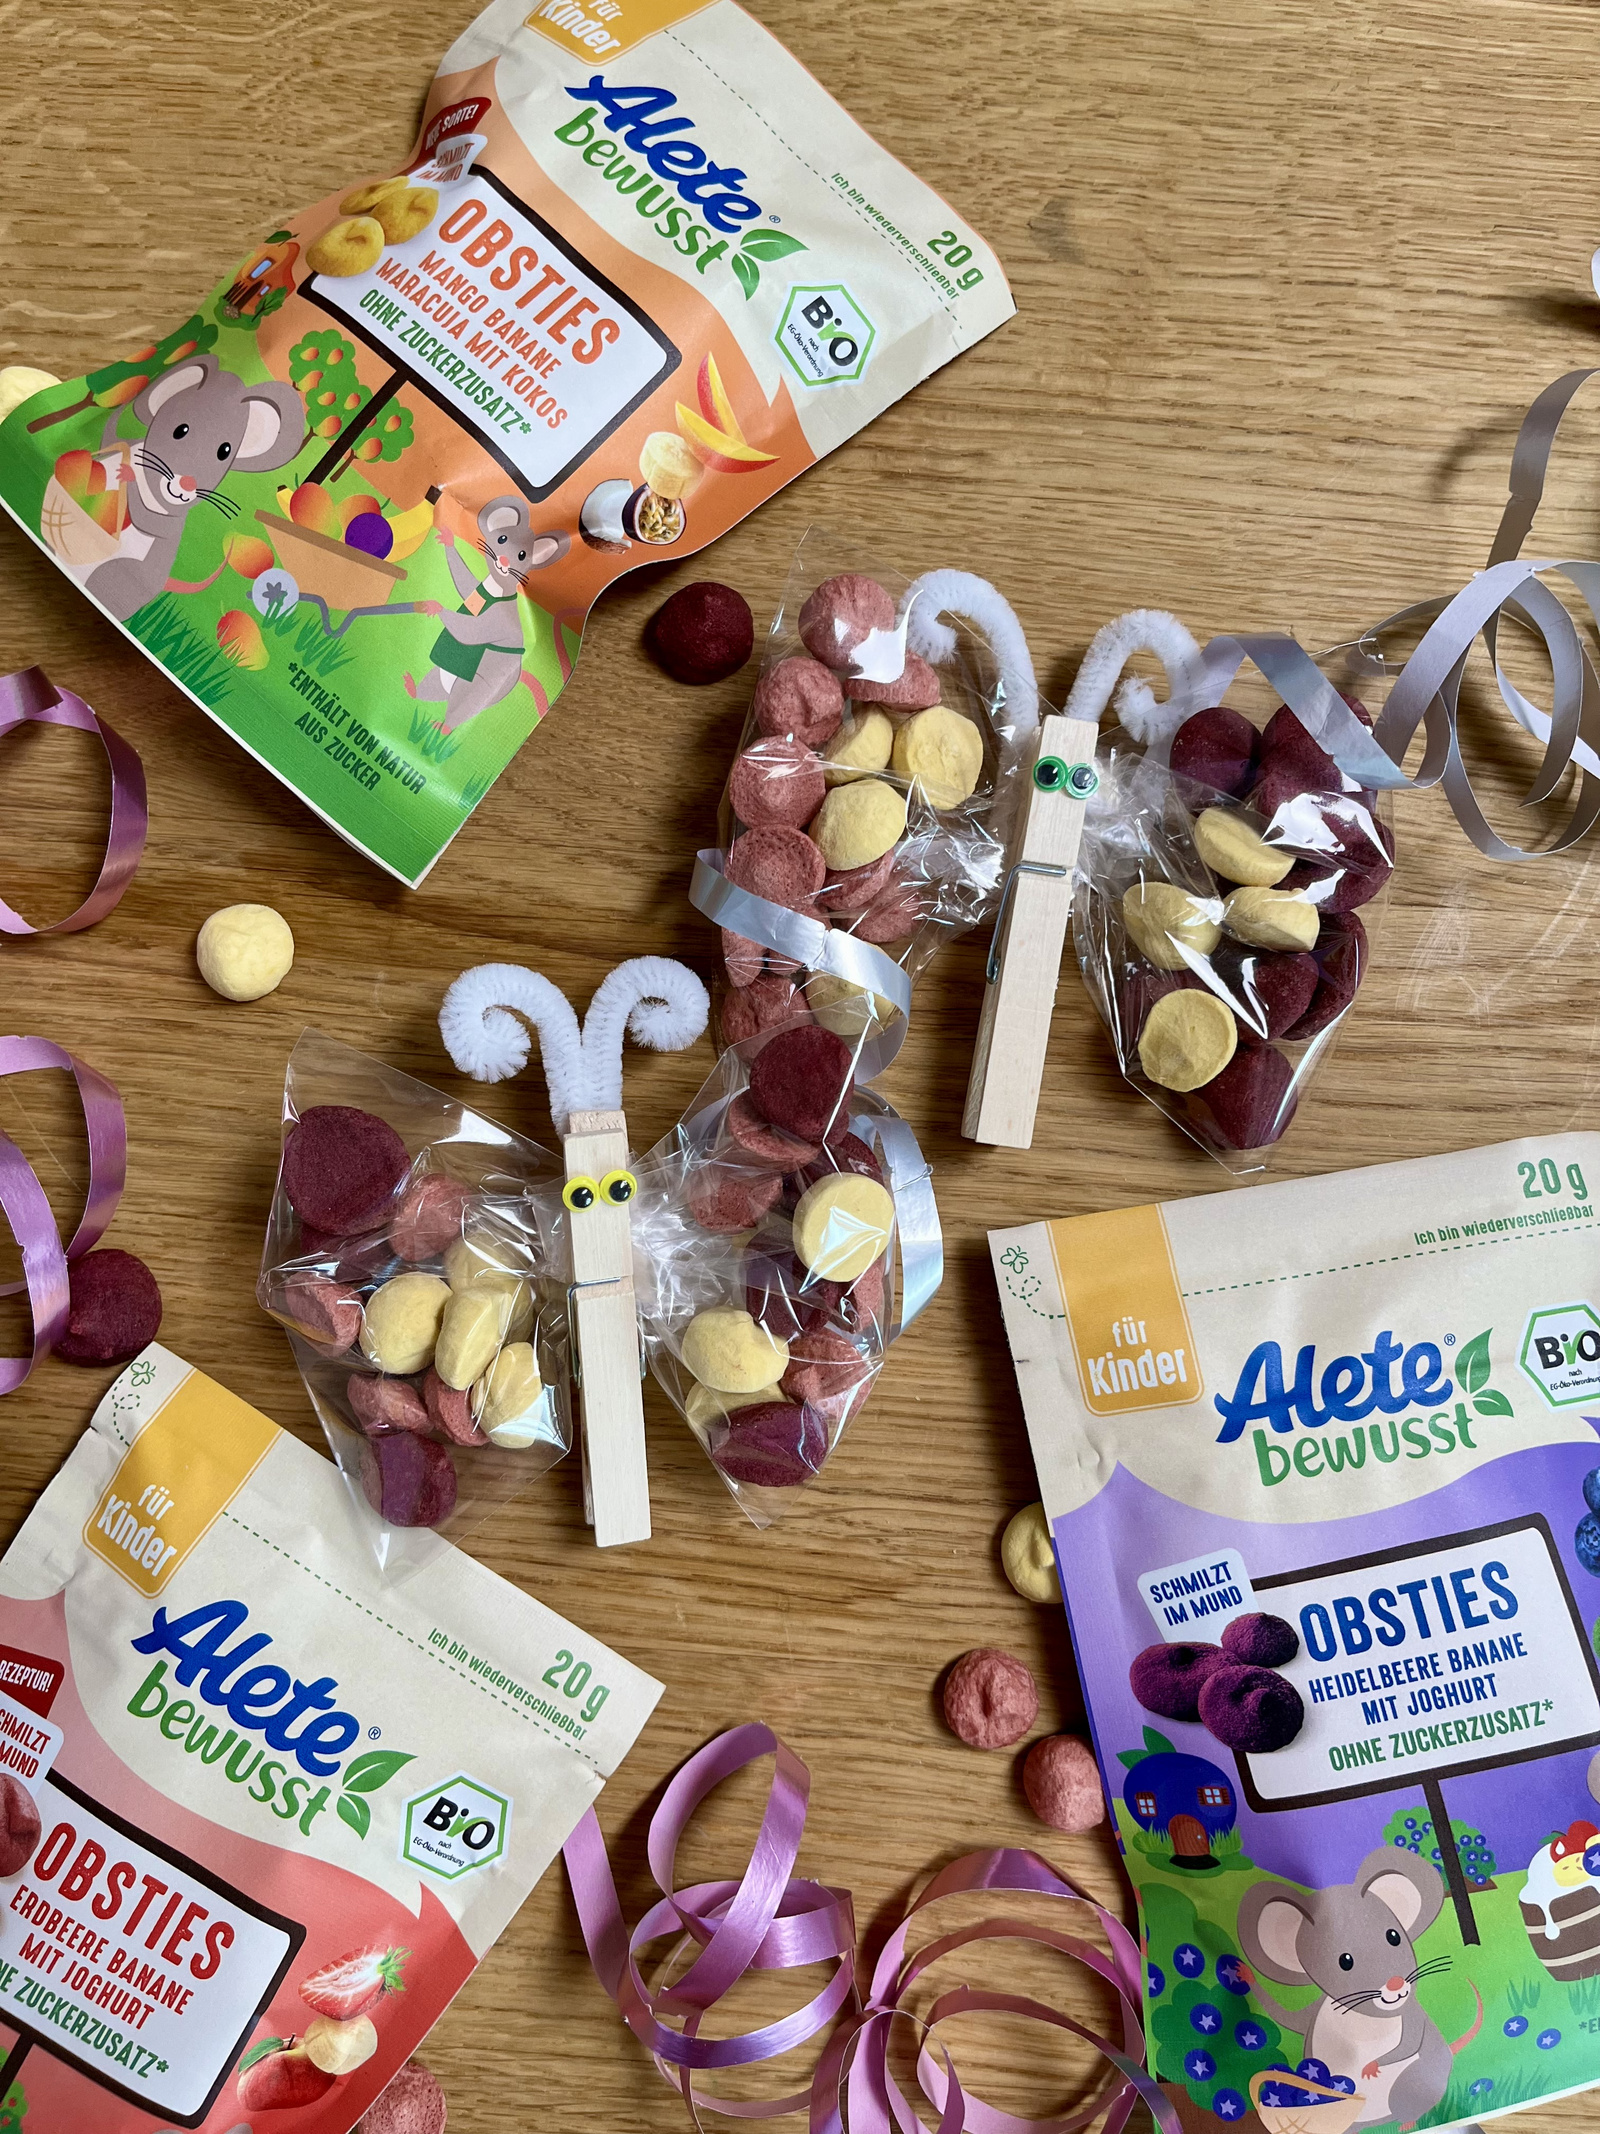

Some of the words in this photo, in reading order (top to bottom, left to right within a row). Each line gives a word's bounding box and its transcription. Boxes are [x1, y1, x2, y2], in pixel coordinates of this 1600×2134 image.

[539, 0, 621, 54] Kinder
[442, 104, 479, 132] SORTE!
[564, 75, 762, 233] Alete
[554, 107, 729, 275] bewusst
[831, 172, 848, 189] Ich
[847, 188, 865, 204] bin
[864, 203, 959, 299] wiederverschließbar
[927, 230, 973, 268] 20
[956, 267, 985, 291] g
[359, 289, 408, 332] OHNE
[418, 250, 490, 313] MANGO
[485, 309, 562, 380] BANANE
[438, 199, 620, 364] OBSTIES
[376, 257, 470, 340] MARACUJA
[465, 331, 509, 370] MIT
[501, 364, 568, 430] KOKOS
[808, 337, 819, 352] nach
[294, 712, 328, 744] AUS
[323, 736, 381, 791] ZUCKER
[345, 719, 380, 756] VON
[374, 746, 427, 795] NATUR
[1517, 1158, 1561, 1199] 20
[1566, 1163, 1588, 1201] g
[1414, 1230, 1436, 1245] Ich
[1438, 1226, 1460, 1242] bin
[1461, 1205, 1594, 1237] wiederverschließbar
[1112, 1316, 1147, 1347] für
[1087, 1349, 1188, 1396] Kinder
[1214, 1330, 1454, 1443] Alete
[1568, 1368, 1583, 1377] nach
[1252, 1402, 1477, 1487] bewusst
[97, 1494, 177, 1577] Kinder
[138, 1484, 175, 1520] für
[1149, 1561, 1233, 1604] SCHMILZT
[1163, 1603, 1190, 1627] IM
[1190, 1584, 1243, 1620] MUND
[1299, 1560, 1519, 1662] OBSTIES
[0, 1660, 54, 1693] REZEPTUR!
[131, 1600, 360, 1777] Alete
[428, 1627, 448, 1648] Ich
[447, 1638, 469, 1663] bin
[468, 1656, 588, 1741] wiederverschließbar
[541, 1649, 593, 1698] 20
[580, 1684, 611, 1722] g
[1308, 1650, 1444, 1704] HEIDELBEERE
[1448, 1632, 1528, 1675] BANANE
[1361, 1697, 1401, 1726] MIT
[1407, 1673, 1499, 1717] JOGHURT
[0, 1740, 40, 1779] MUND
[127, 1660, 332, 1837] bewusst
[1328, 1741, 1387, 1772] OHNE
[438, 1840, 452, 1849] nach
[33, 1822, 235, 1980] OBSTIES
[11, 1885, 109, 1963] ERDBEERE
[107, 1946, 194, 2017] BANANE
[18, 1932, 65, 1974] MIT
[61, 1958, 155, 2030] JOGHURT
